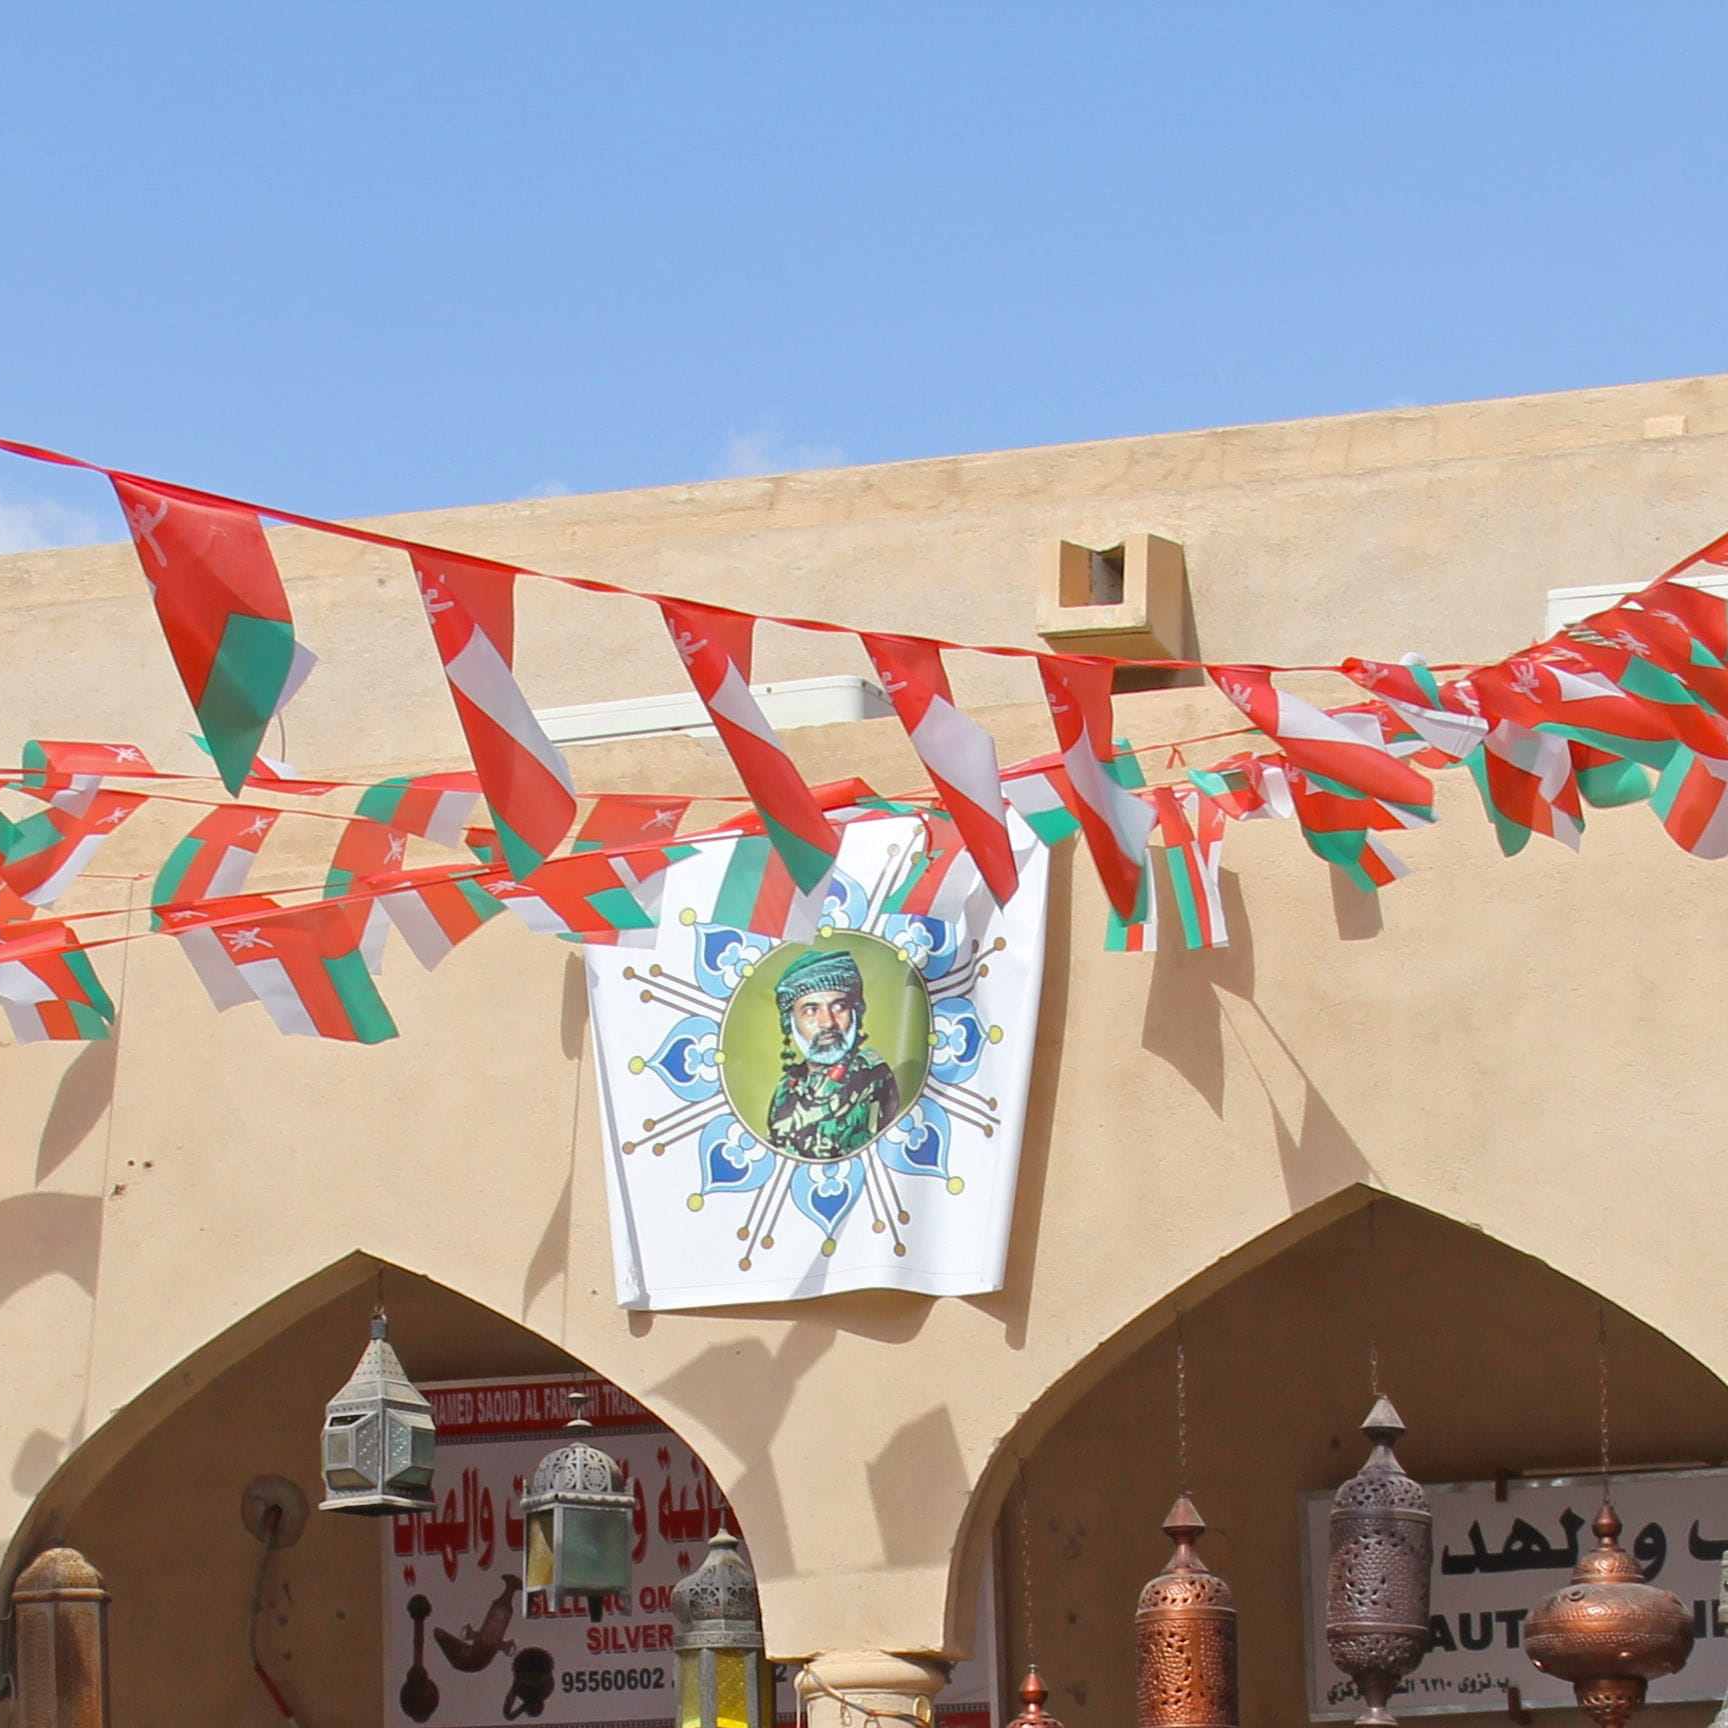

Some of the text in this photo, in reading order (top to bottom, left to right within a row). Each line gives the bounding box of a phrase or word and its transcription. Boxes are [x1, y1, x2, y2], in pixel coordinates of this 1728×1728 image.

[477, 1389, 521, 1423] SAOUD
[524, 1388, 541, 1420] AL
[586, 1623, 674, 1653] SILVER
[561, 1667, 665, 1693] 95560602
